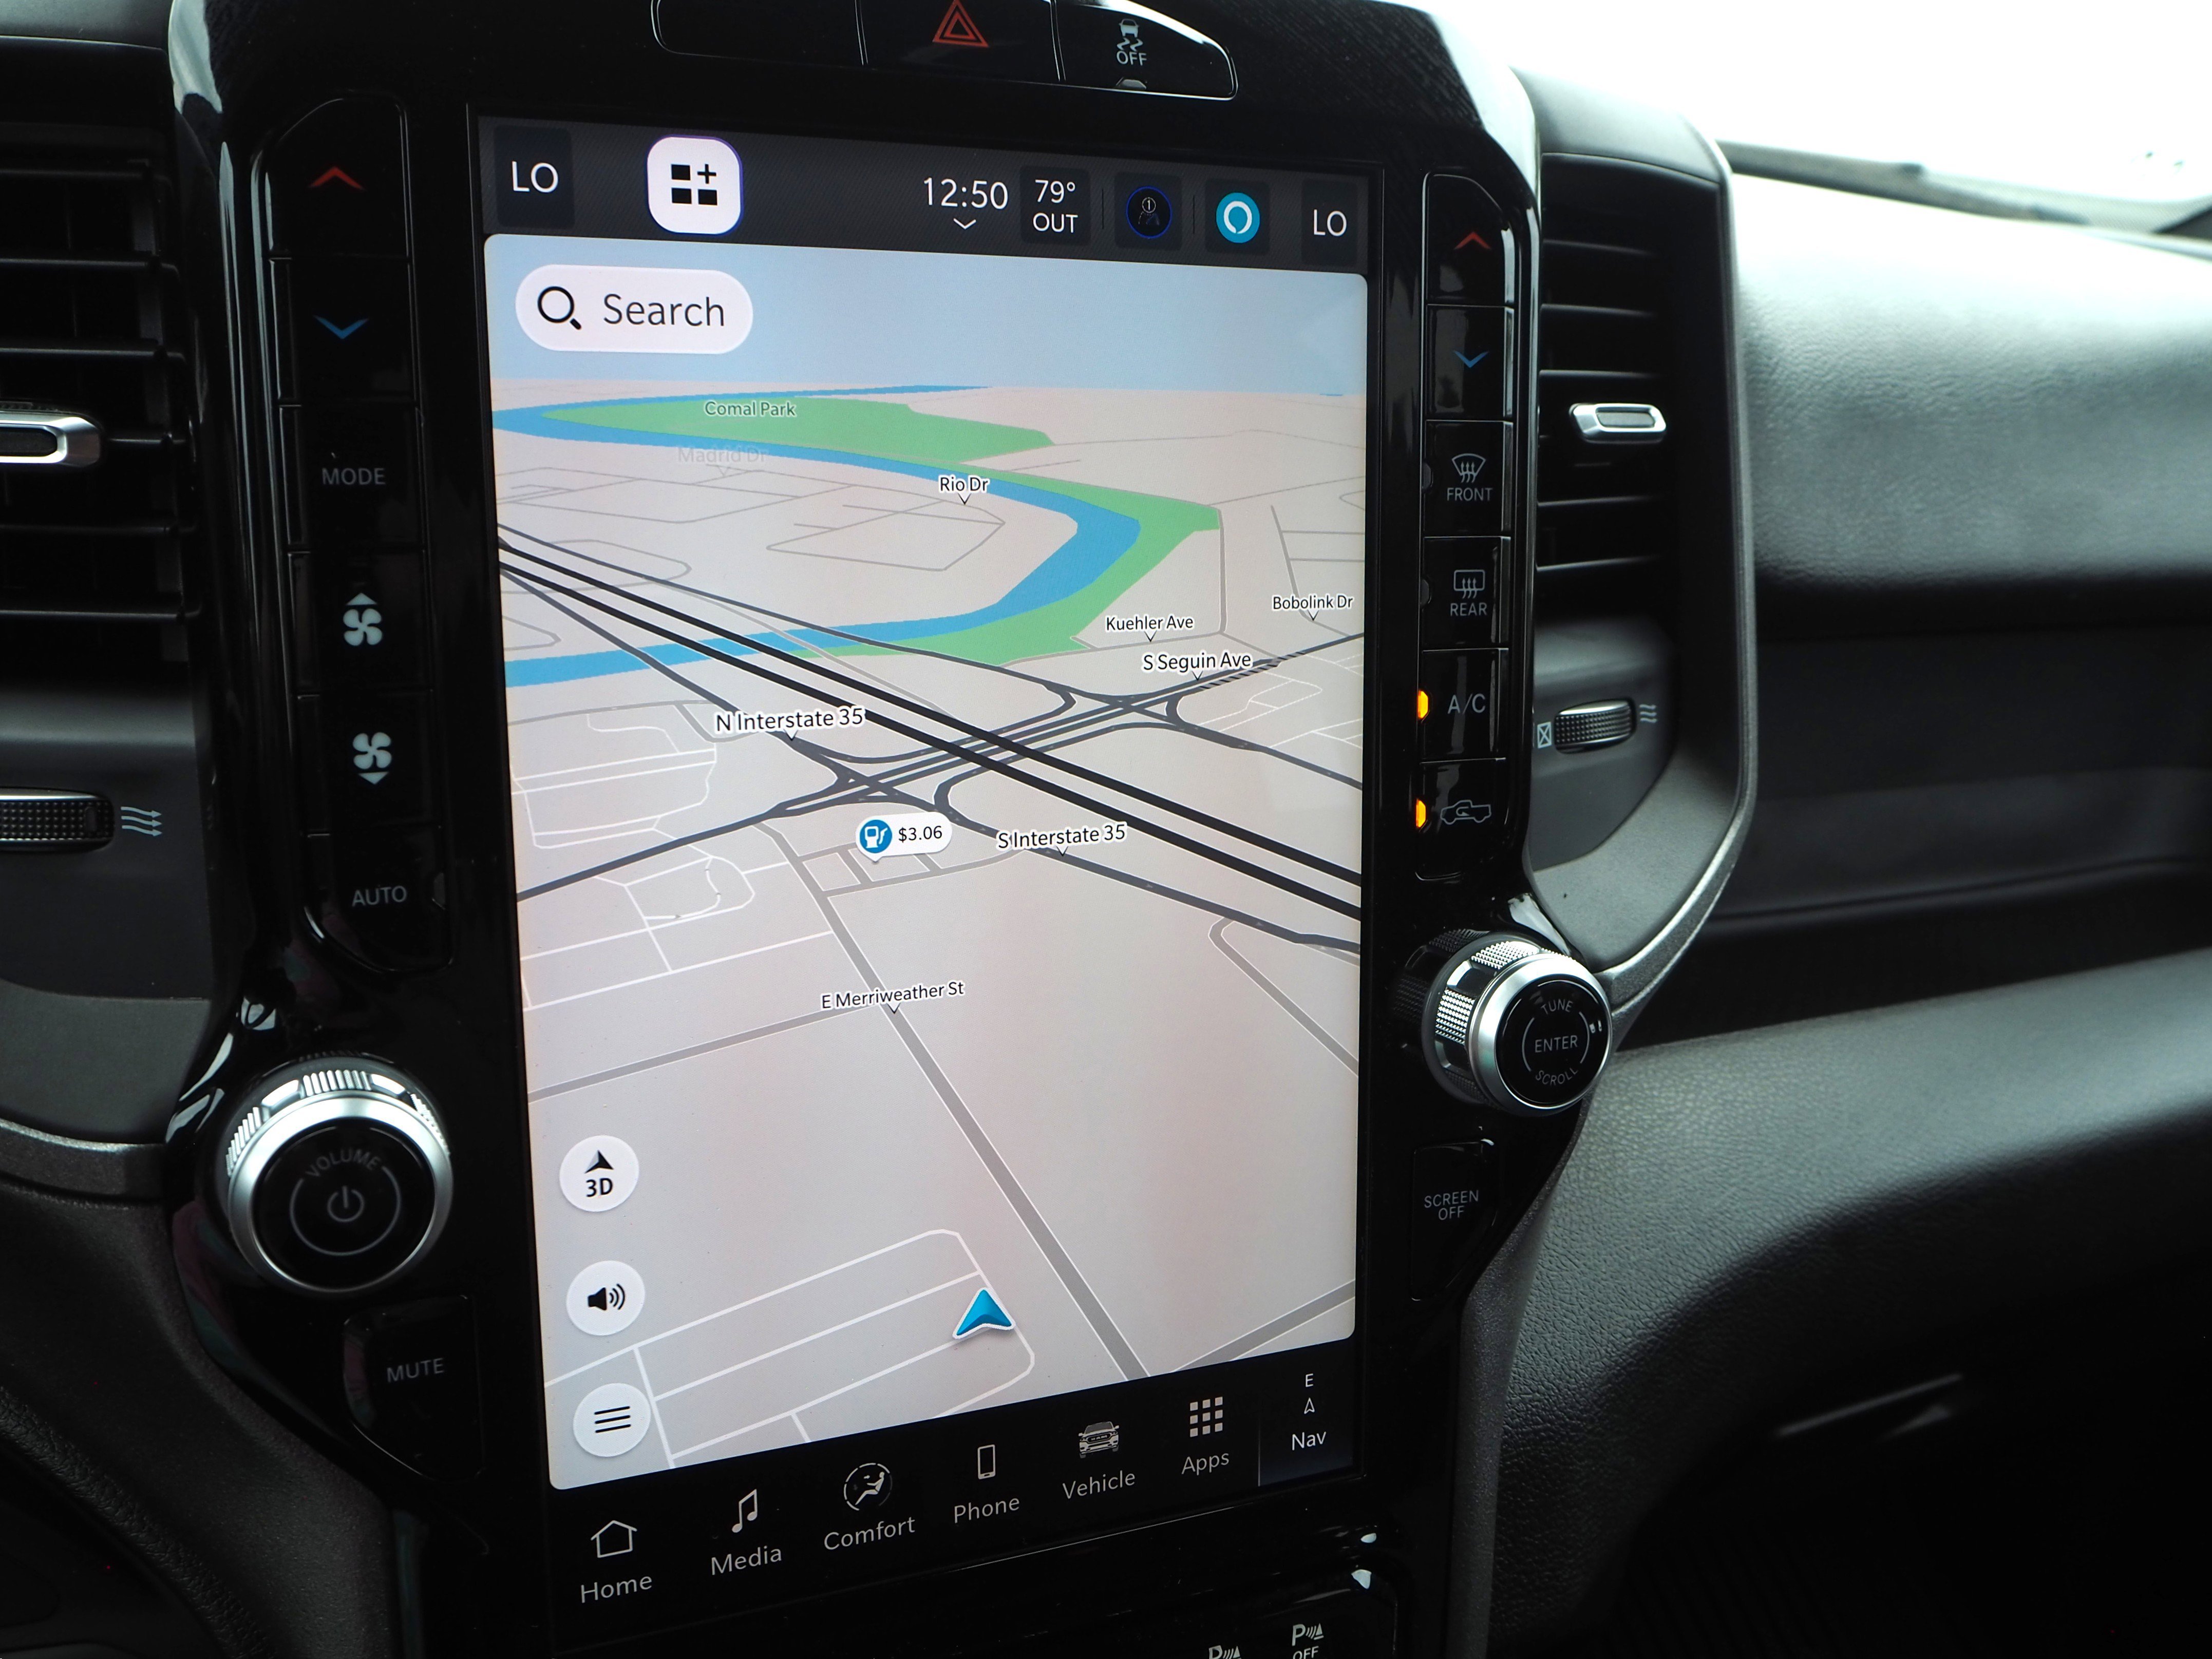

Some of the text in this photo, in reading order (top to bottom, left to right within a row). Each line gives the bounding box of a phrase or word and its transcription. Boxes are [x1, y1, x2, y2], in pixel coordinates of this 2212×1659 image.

[1116, 51, 1147, 66] OFF
[512, 161, 559, 193] LO
[923, 177, 1008, 209] 12:50
[1034, 179, 1076, 203] 79°
[1033, 213, 1078, 233] OUT
[1313, 209, 1347, 237] LO
[603, 293, 725, 327] Search
[705, 402, 796, 417] Comal Park
[677, 446, 767, 463] Madrid Dr
[322, 468, 385, 485] MODE
[940, 477, 989, 493] Rio Dr
[1447, 487, 1493, 501] FRONT
[1273, 595, 1353, 610] Bobolink Dr
[1450, 602, 1487, 616] REAR
[1106, 616, 1194, 631] Kuehler Ave
[1143, 651, 1251, 673] S Seguin Ave
[1447, 693, 1486, 714] A/C
[716, 708, 864, 732] N Interstate 35
[898, 825, 943, 844] $3.06
[998, 825, 1125, 849] S Interstate 35
[352, 886, 407, 906] AUTO
[822, 982, 964, 1009] E Merriweather St
[1541, 999, 1574, 1014] TUNE
[1534, 1036, 1578, 1053] ENTER
[1535, 1066, 1578, 1085] SCROLL
[308, 1149, 383, 1179] VOLUME
[586, 1177, 613, 1197] 3D
[1424, 1190, 1479, 1208] SCREEN
[1438, 1206, 1464, 1221] OFF
[387, 1358, 445, 1384] MUTE
[1304, 1374, 1314, 1387] E
[1292, 1431, 1326, 1451] Nav
[1181, 1451, 1230, 1476] Apps
[1062, 1471, 1136, 1500] Vehicle
[953, 1495, 1020, 1523] Phone
[824, 1516, 915, 1551] Comfort
[711, 1546, 782, 1575] Media
[580, 1575, 653, 1604] Home
[1293, 1646, 1319, 1659] OFF
